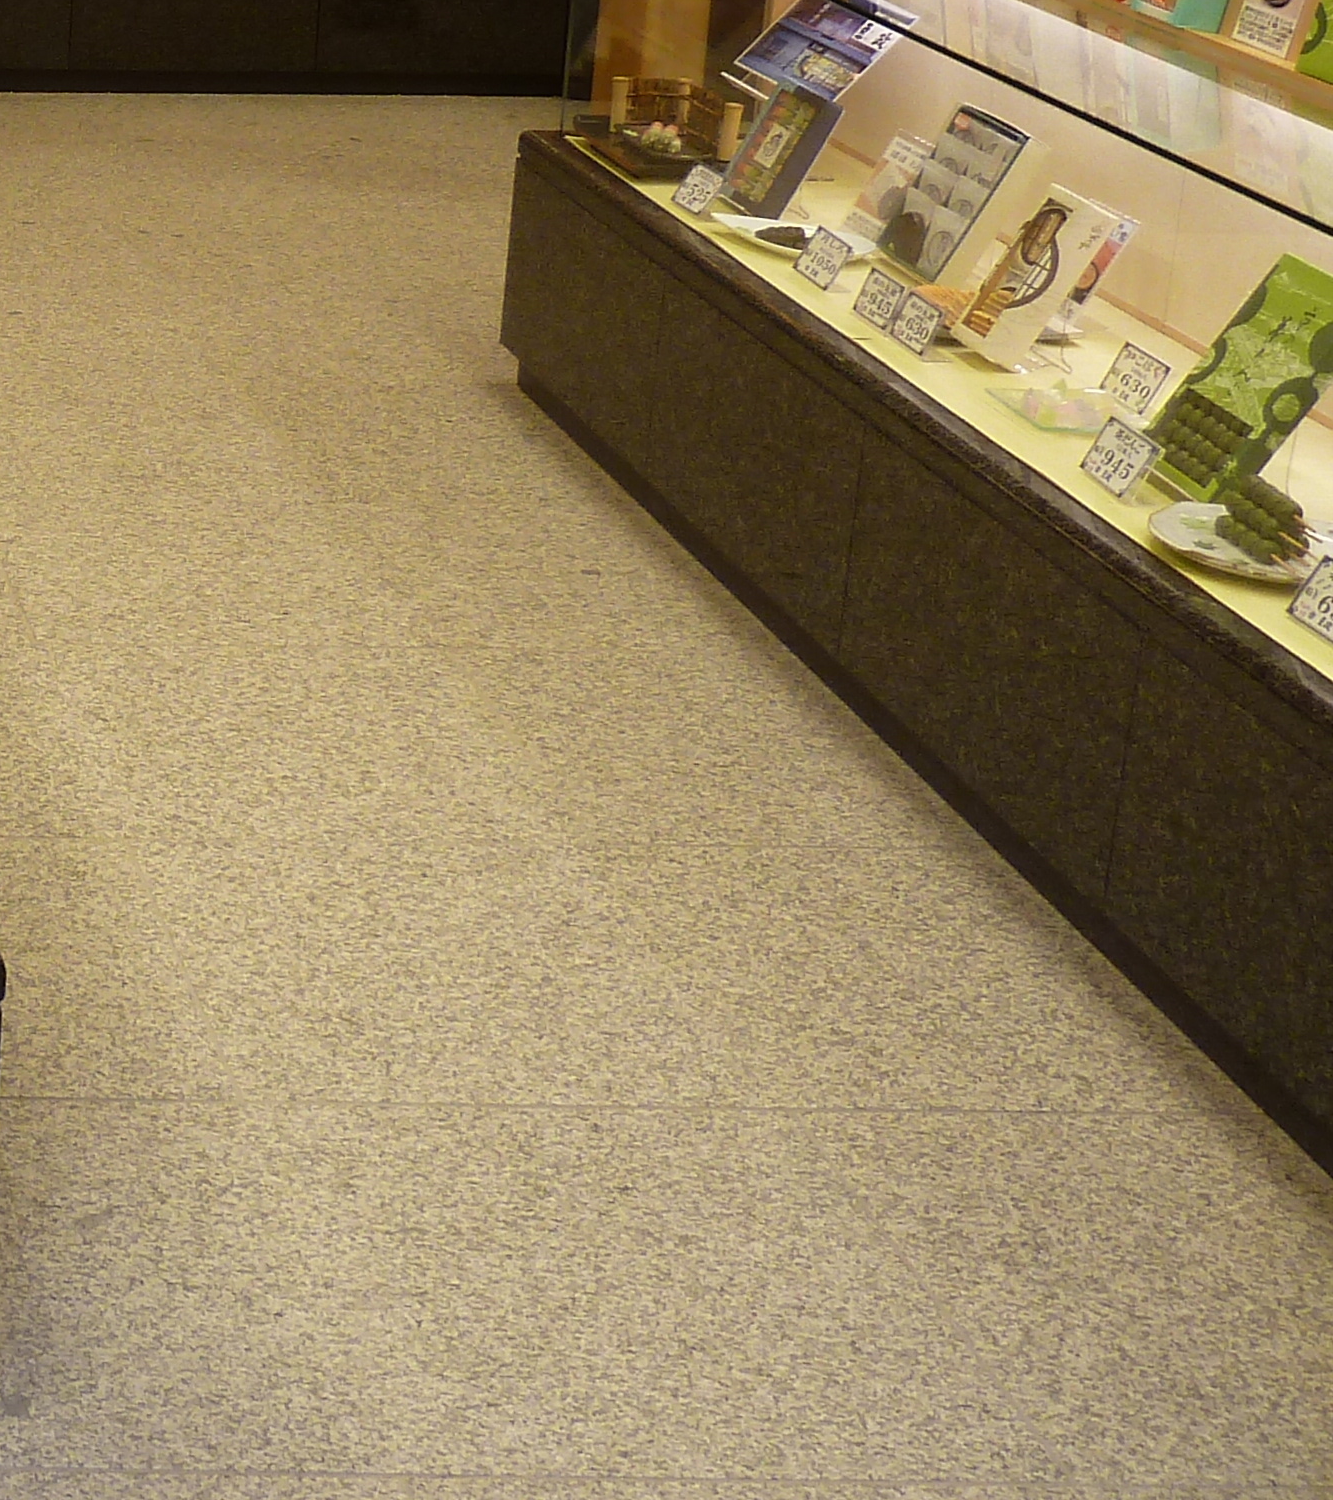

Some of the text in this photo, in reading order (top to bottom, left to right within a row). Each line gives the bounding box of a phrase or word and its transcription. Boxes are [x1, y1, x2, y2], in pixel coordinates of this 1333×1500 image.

[810, 253, 836, 275] 1050
[867, 292, 892, 314] 945
[906, 318, 929, 340] 630
[1120, 373, 1151, 399] 630
[1101, 449, 1134, 480] 945
